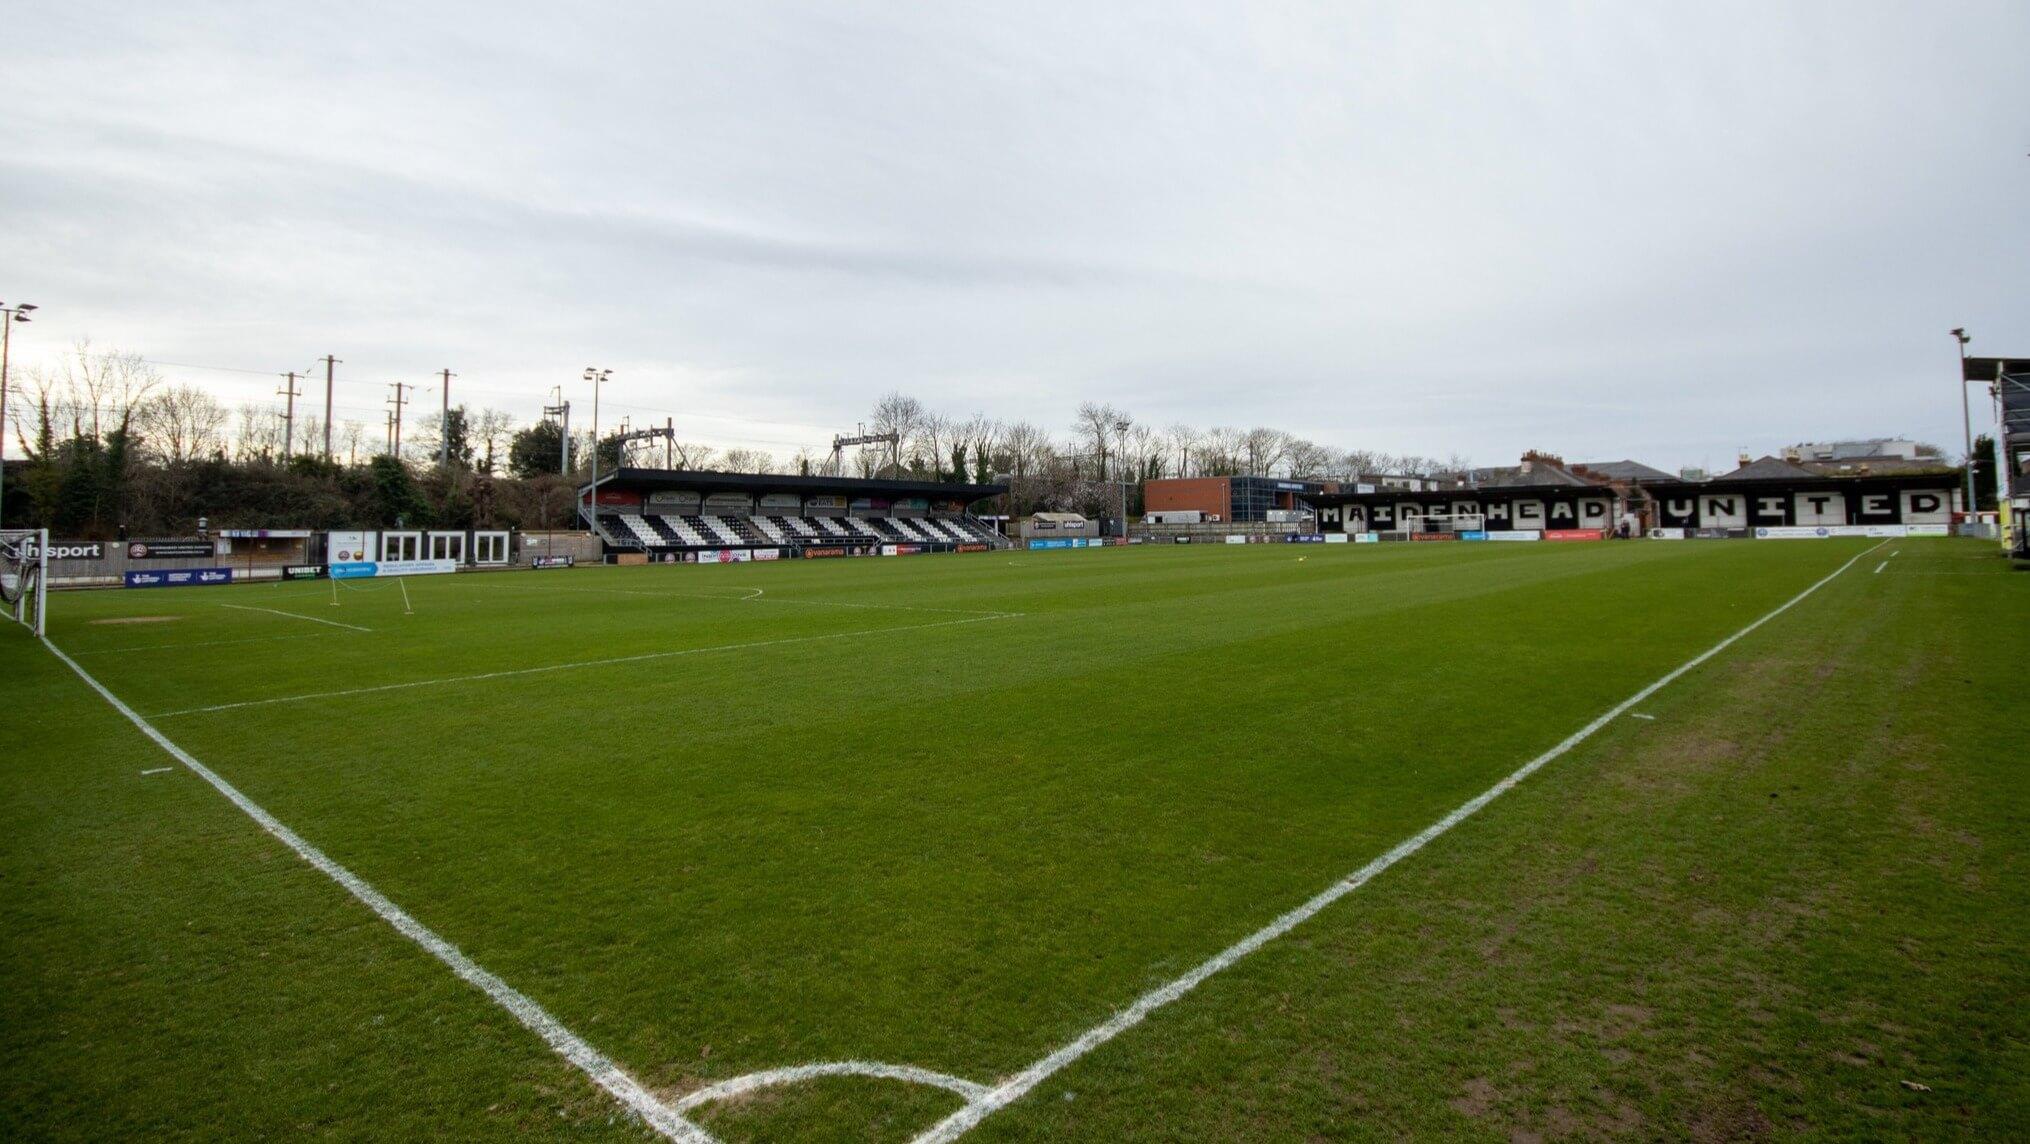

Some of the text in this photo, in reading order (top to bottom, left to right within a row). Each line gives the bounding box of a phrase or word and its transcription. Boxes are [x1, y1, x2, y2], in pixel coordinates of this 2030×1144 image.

[1323, 494, 1940, 522] MAIDENHEAD UNITED
[14, 544, 100, 559] hsport
[813, 549, 844, 557] vanarama
[288, 566, 321, 574] UNIBET
